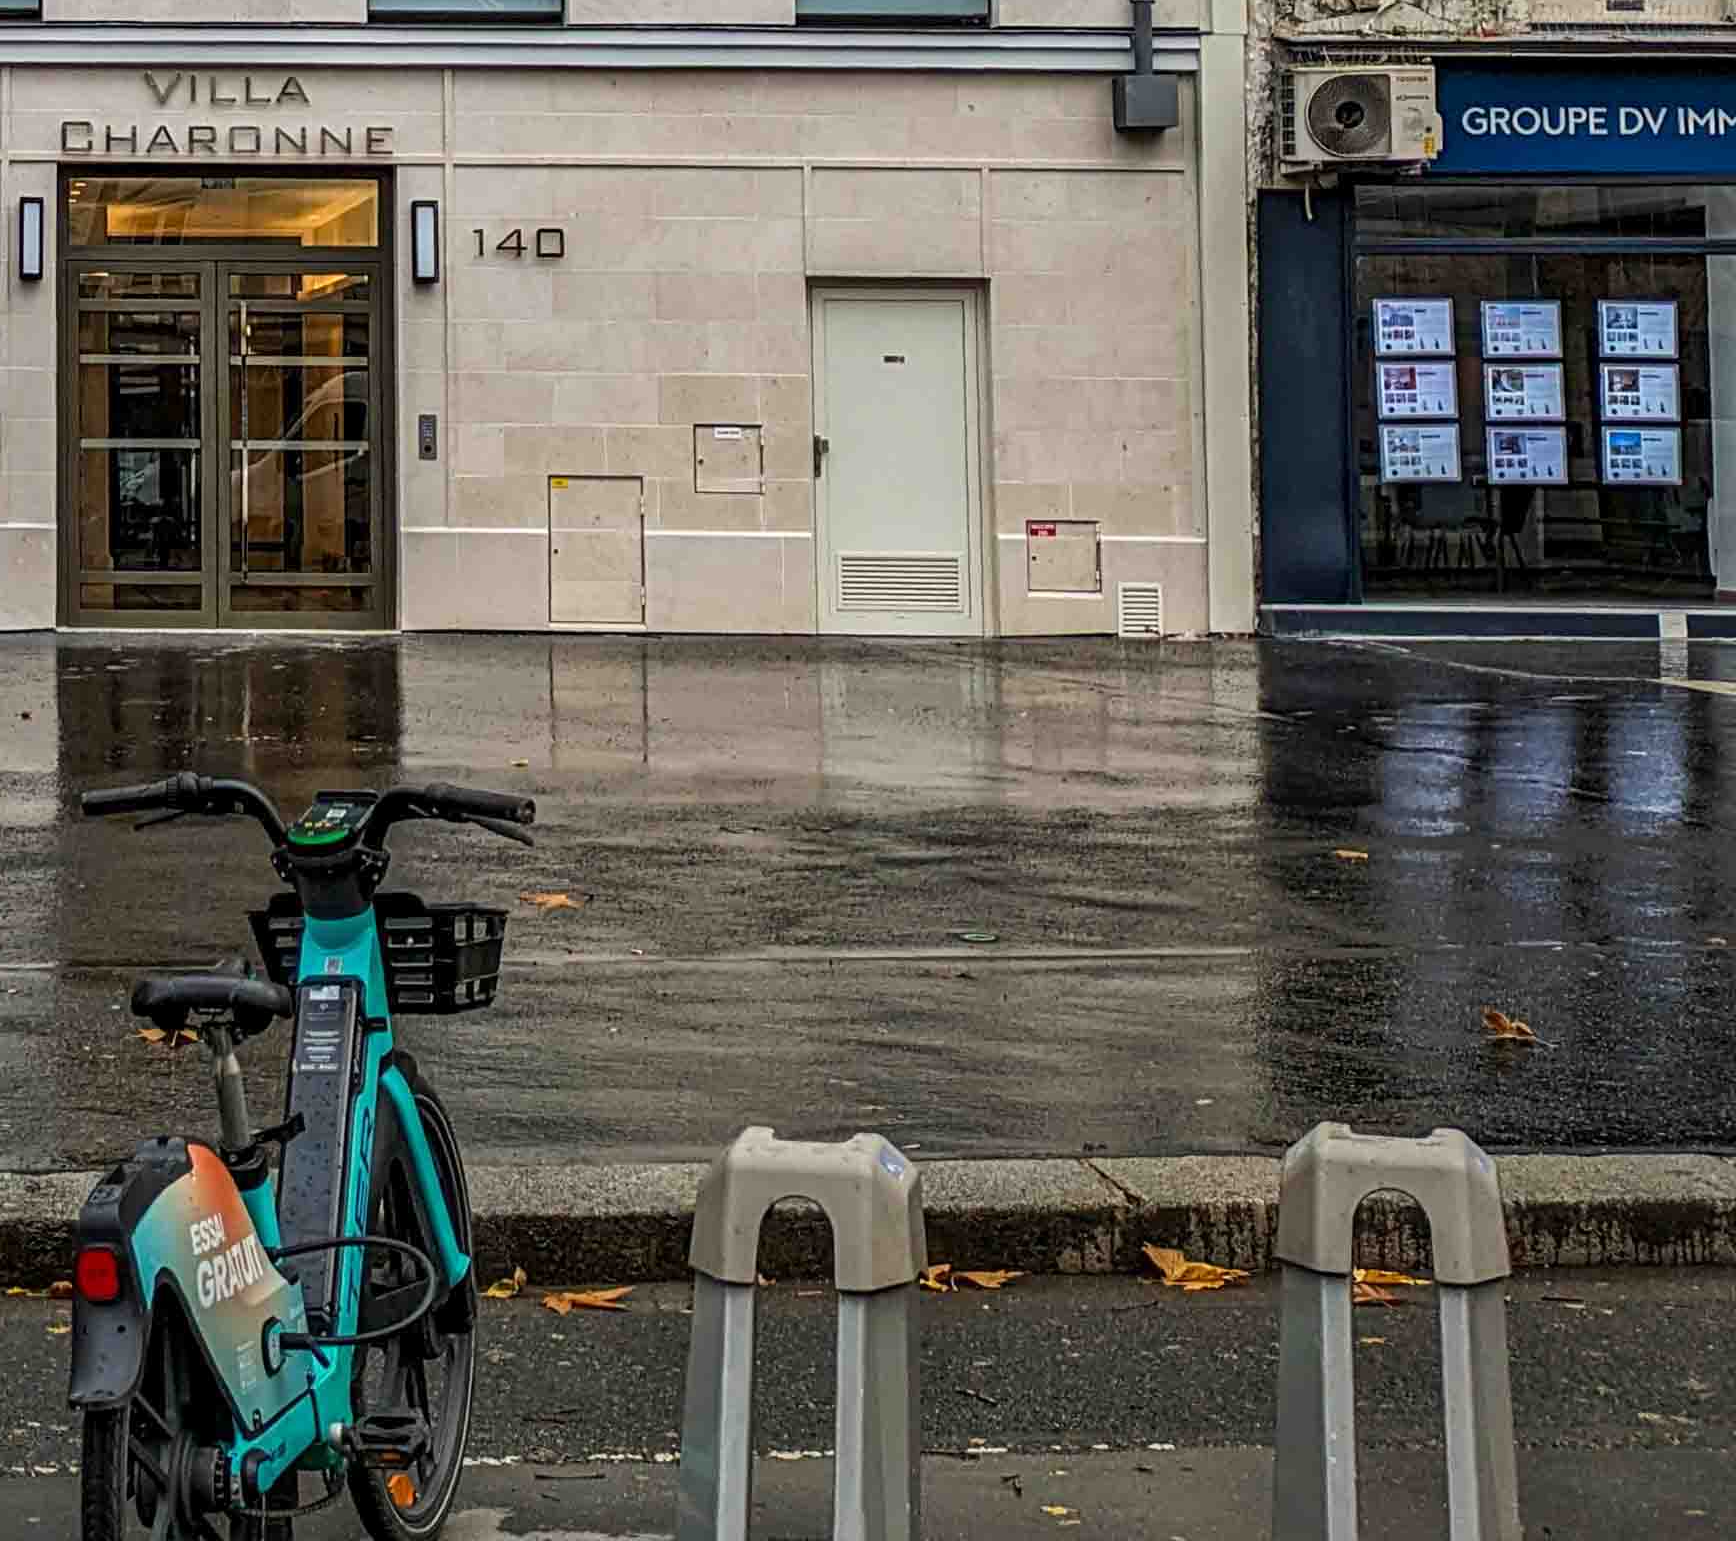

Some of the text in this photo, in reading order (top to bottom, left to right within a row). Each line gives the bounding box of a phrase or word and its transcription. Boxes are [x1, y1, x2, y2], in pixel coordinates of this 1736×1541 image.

[143, 70, 310, 105] VILLA
[61, 121, 393, 155] CHARONNE
[1462, 107, 1609, 136] GROUPE
[1618, 107, 1668, 136] DV
[472, 228, 565, 258] 140
[197, 1233, 264, 1310] GRATUIT
